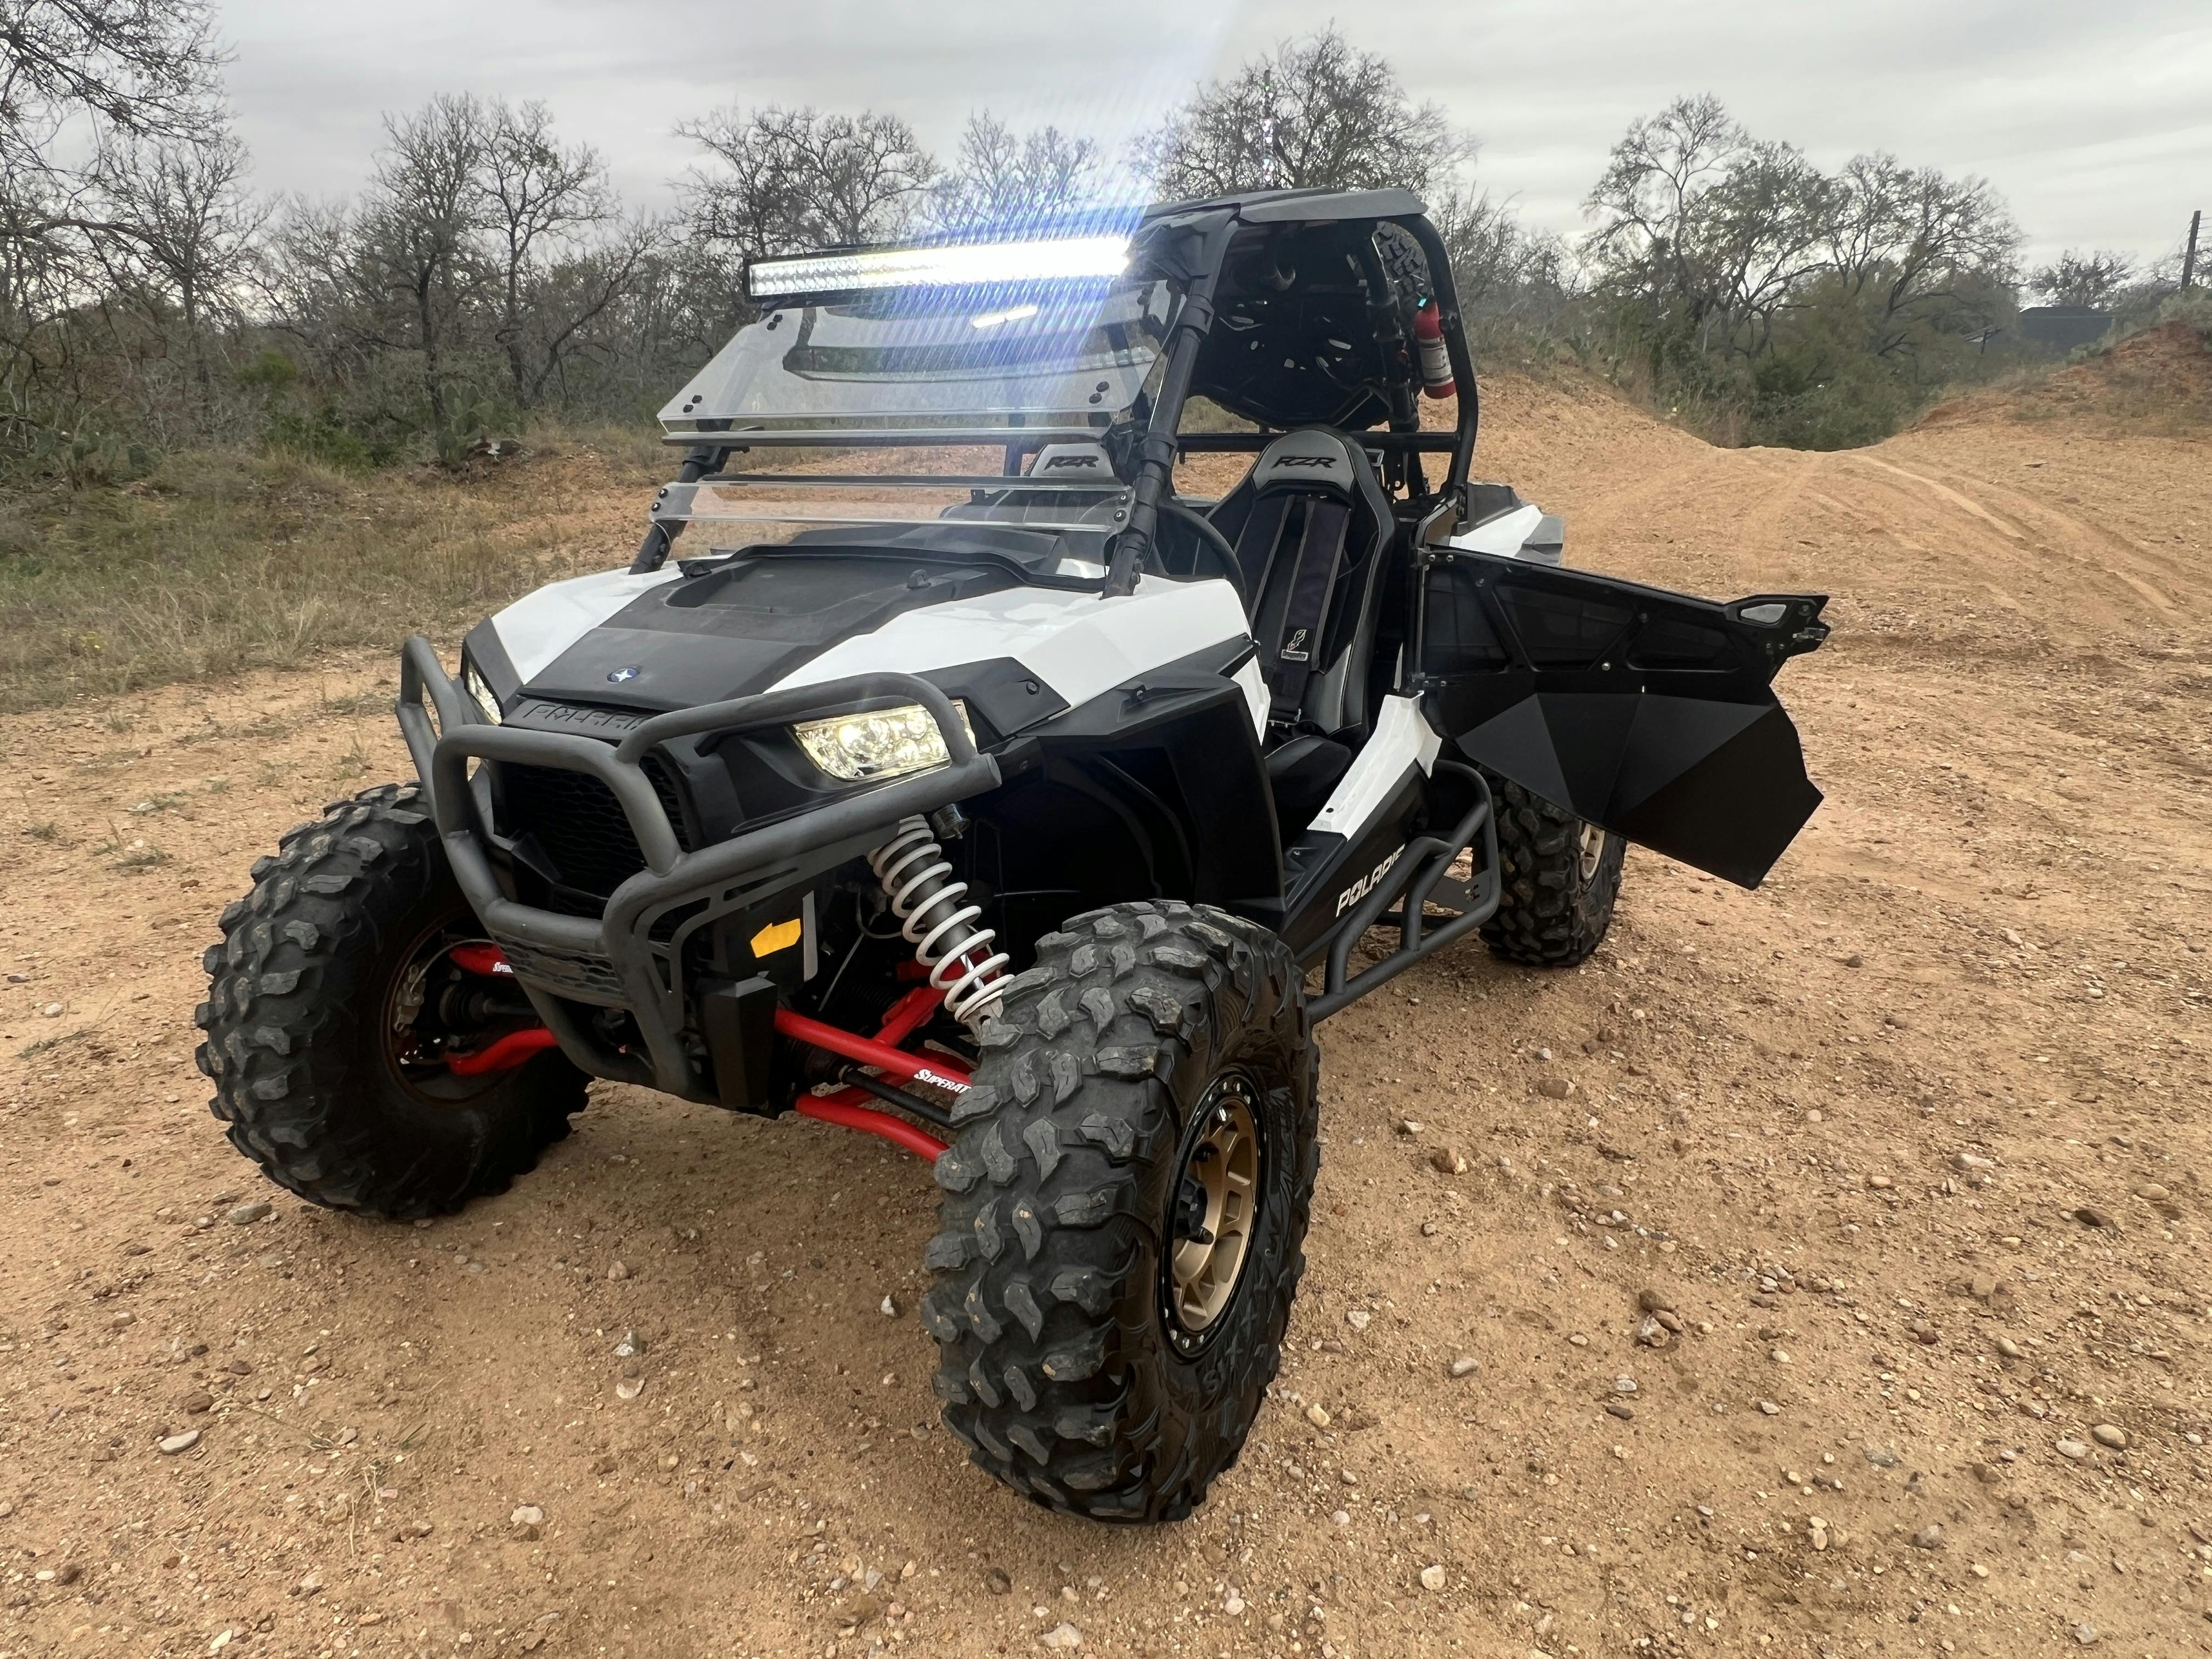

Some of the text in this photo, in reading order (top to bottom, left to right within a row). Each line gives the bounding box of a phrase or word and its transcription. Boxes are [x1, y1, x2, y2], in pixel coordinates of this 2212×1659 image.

[1044, 455, 1099, 470] RZR
[1271, 455, 1337, 469] RZR
[522, 704, 652, 731] POLARI
[913, 1069, 972, 1093] SUPERAT
